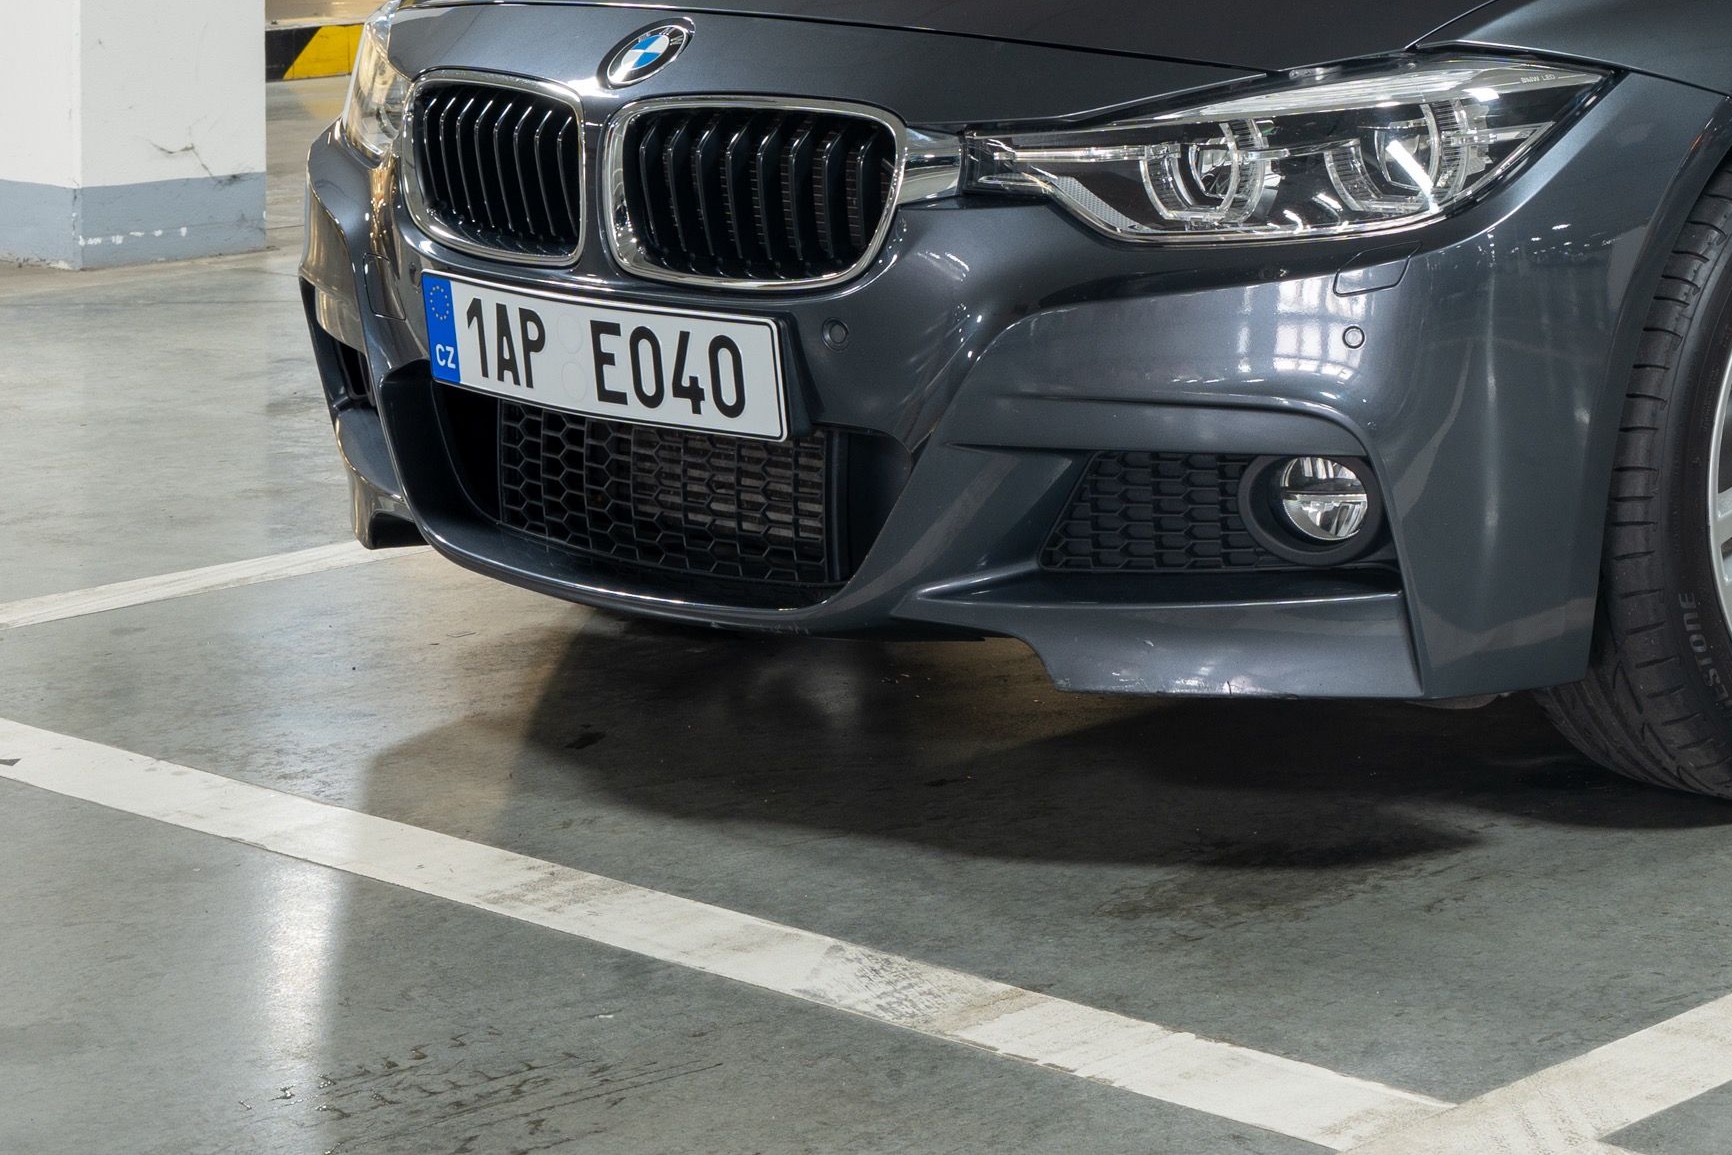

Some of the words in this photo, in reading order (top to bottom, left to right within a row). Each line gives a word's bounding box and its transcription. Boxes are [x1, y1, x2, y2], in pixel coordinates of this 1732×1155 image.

[435, 343, 457, 369] CZ
[466, 297, 547, 389] 1AP
[589, 319, 747, 419] E040
